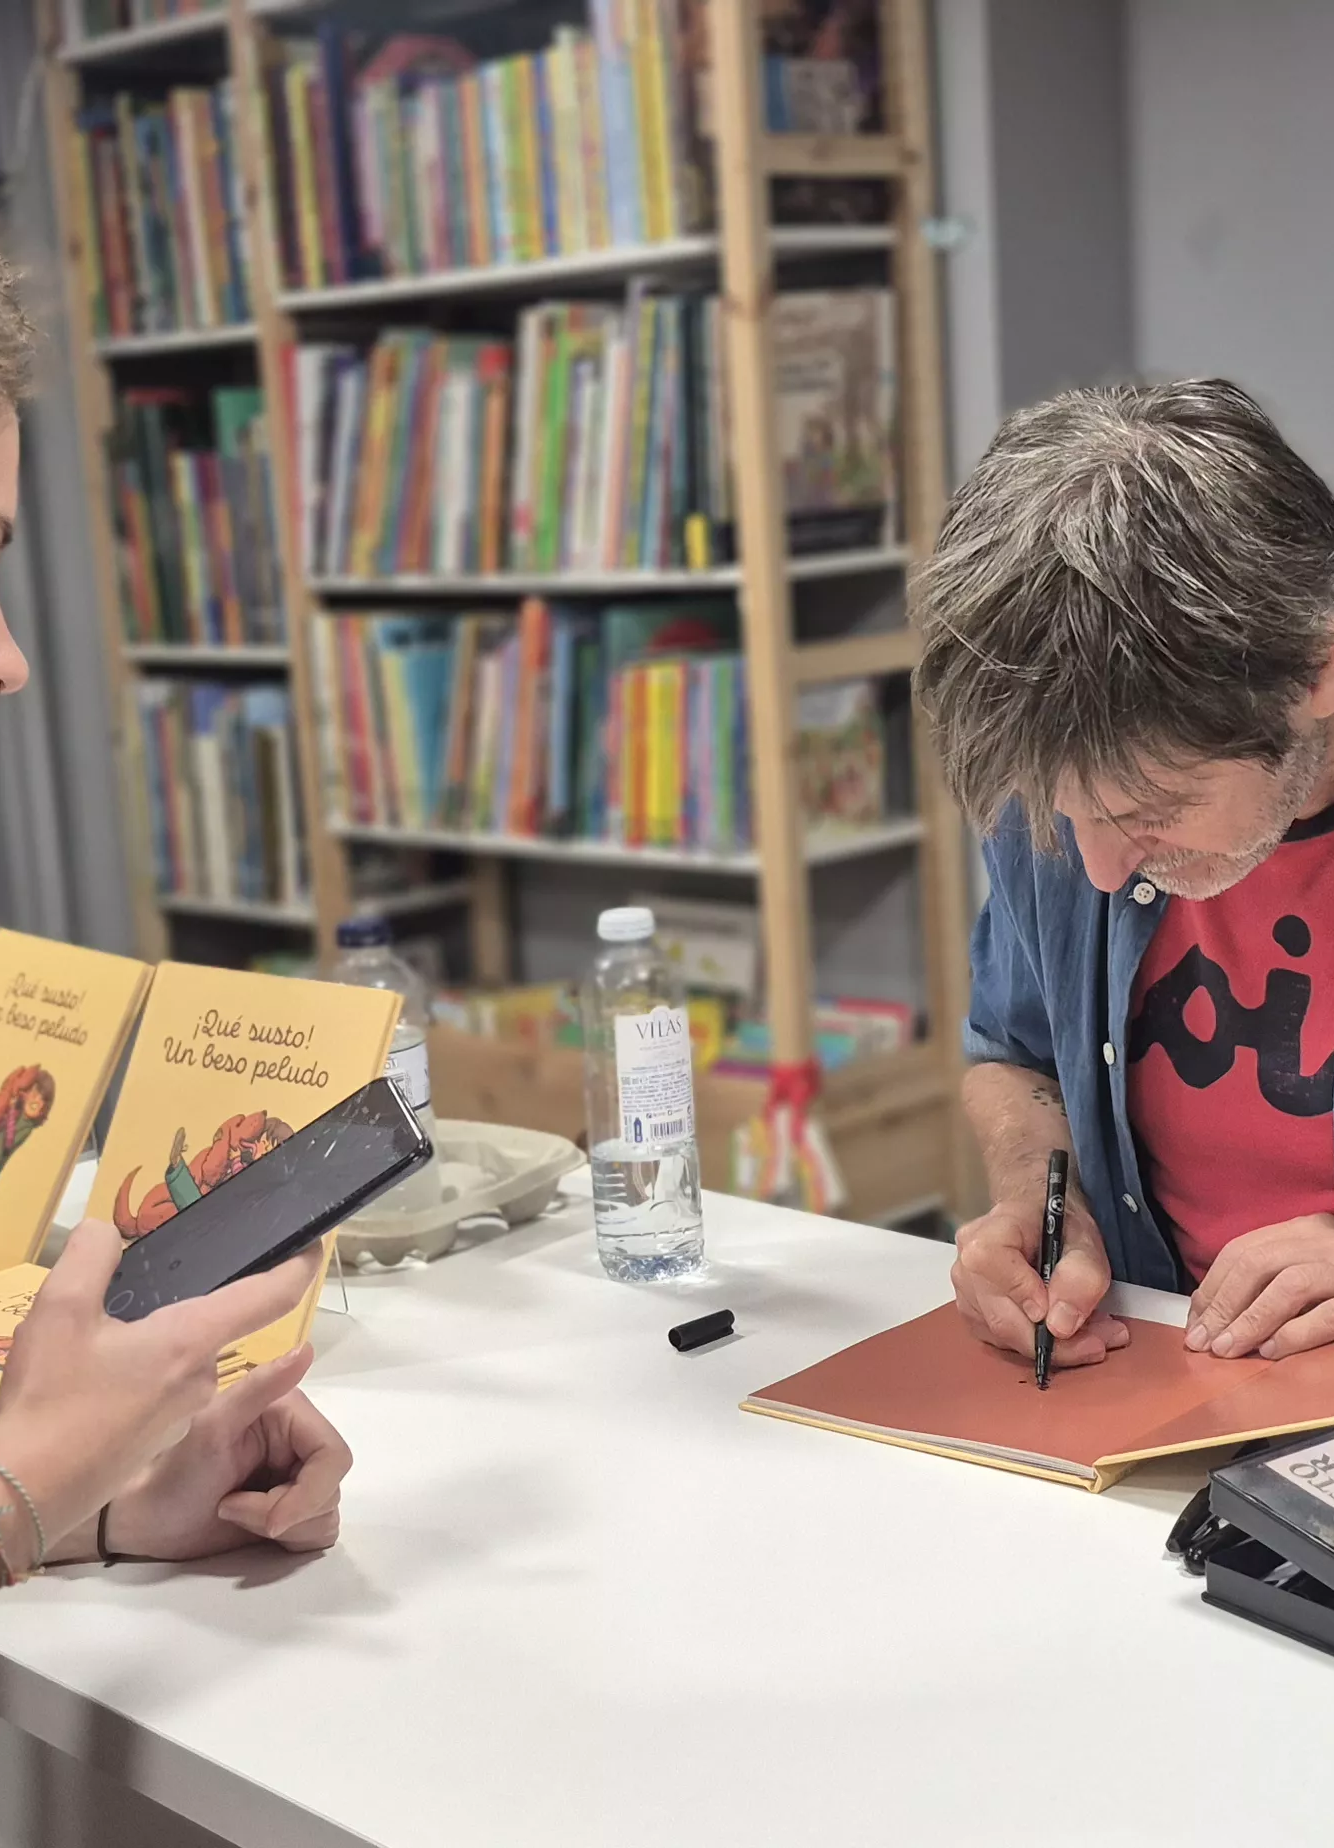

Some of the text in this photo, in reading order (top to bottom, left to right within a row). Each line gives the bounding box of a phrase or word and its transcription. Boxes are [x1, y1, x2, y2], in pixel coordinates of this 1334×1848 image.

[41, 987, 87, 1013] susto!
[6, 1003, 37, 1033] beso
[35, 1015, 88, 1047] peludo
[192, 1008, 315, 1050] ¡Qué susto!
[635, 1016, 682, 1039] VILAS
[163, 1036, 329, 1089] Un beso peludo
